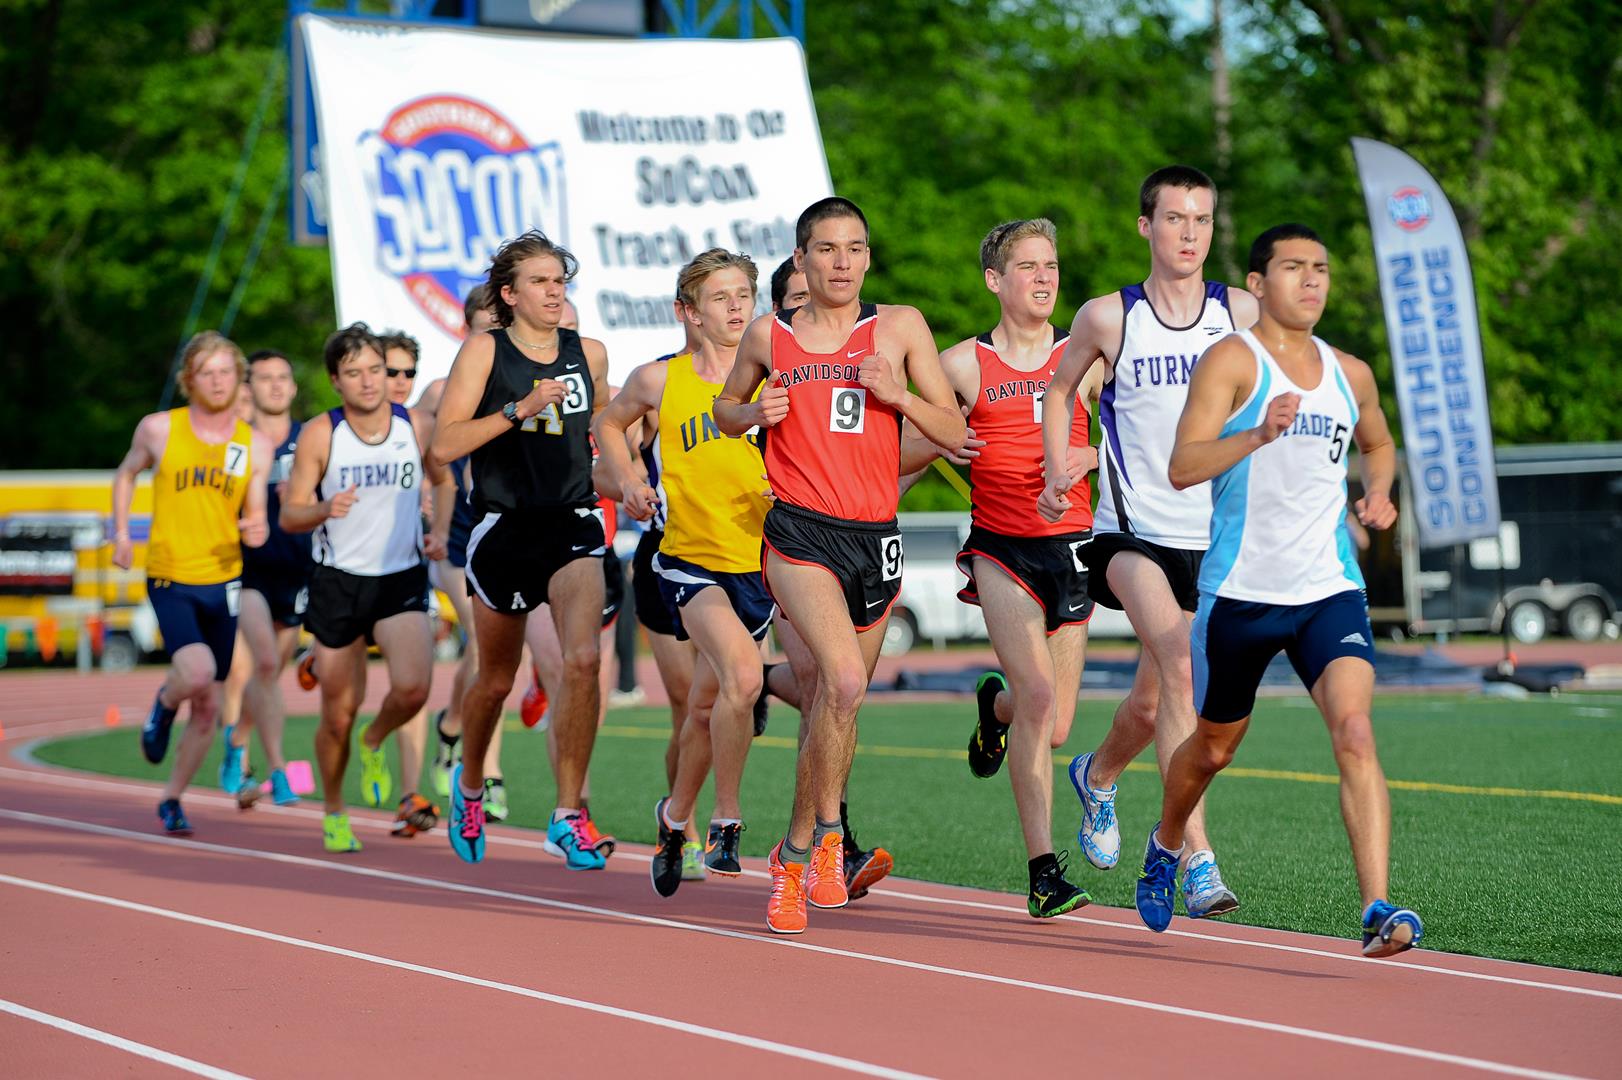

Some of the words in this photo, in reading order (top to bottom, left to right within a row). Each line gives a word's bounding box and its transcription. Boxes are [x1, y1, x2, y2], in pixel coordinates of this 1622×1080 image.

[577, 110, 708, 142] Welcome
[747, 109, 784, 139] the
[637, 155, 757, 207] SoCon
[594, 222, 694, 266] Track
[563, 377, 583, 409] 3
[1389, 252, 1454, 528] SOUTHERN
[1423, 246, 1487, 525] CONFERENCE
[836, 391, 861, 430] 9
[229, 446, 243, 471] 7
[1329, 422, 1348, 464] 5
[401, 462, 414, 489] 8
[885, 538, 901, 577] 9
